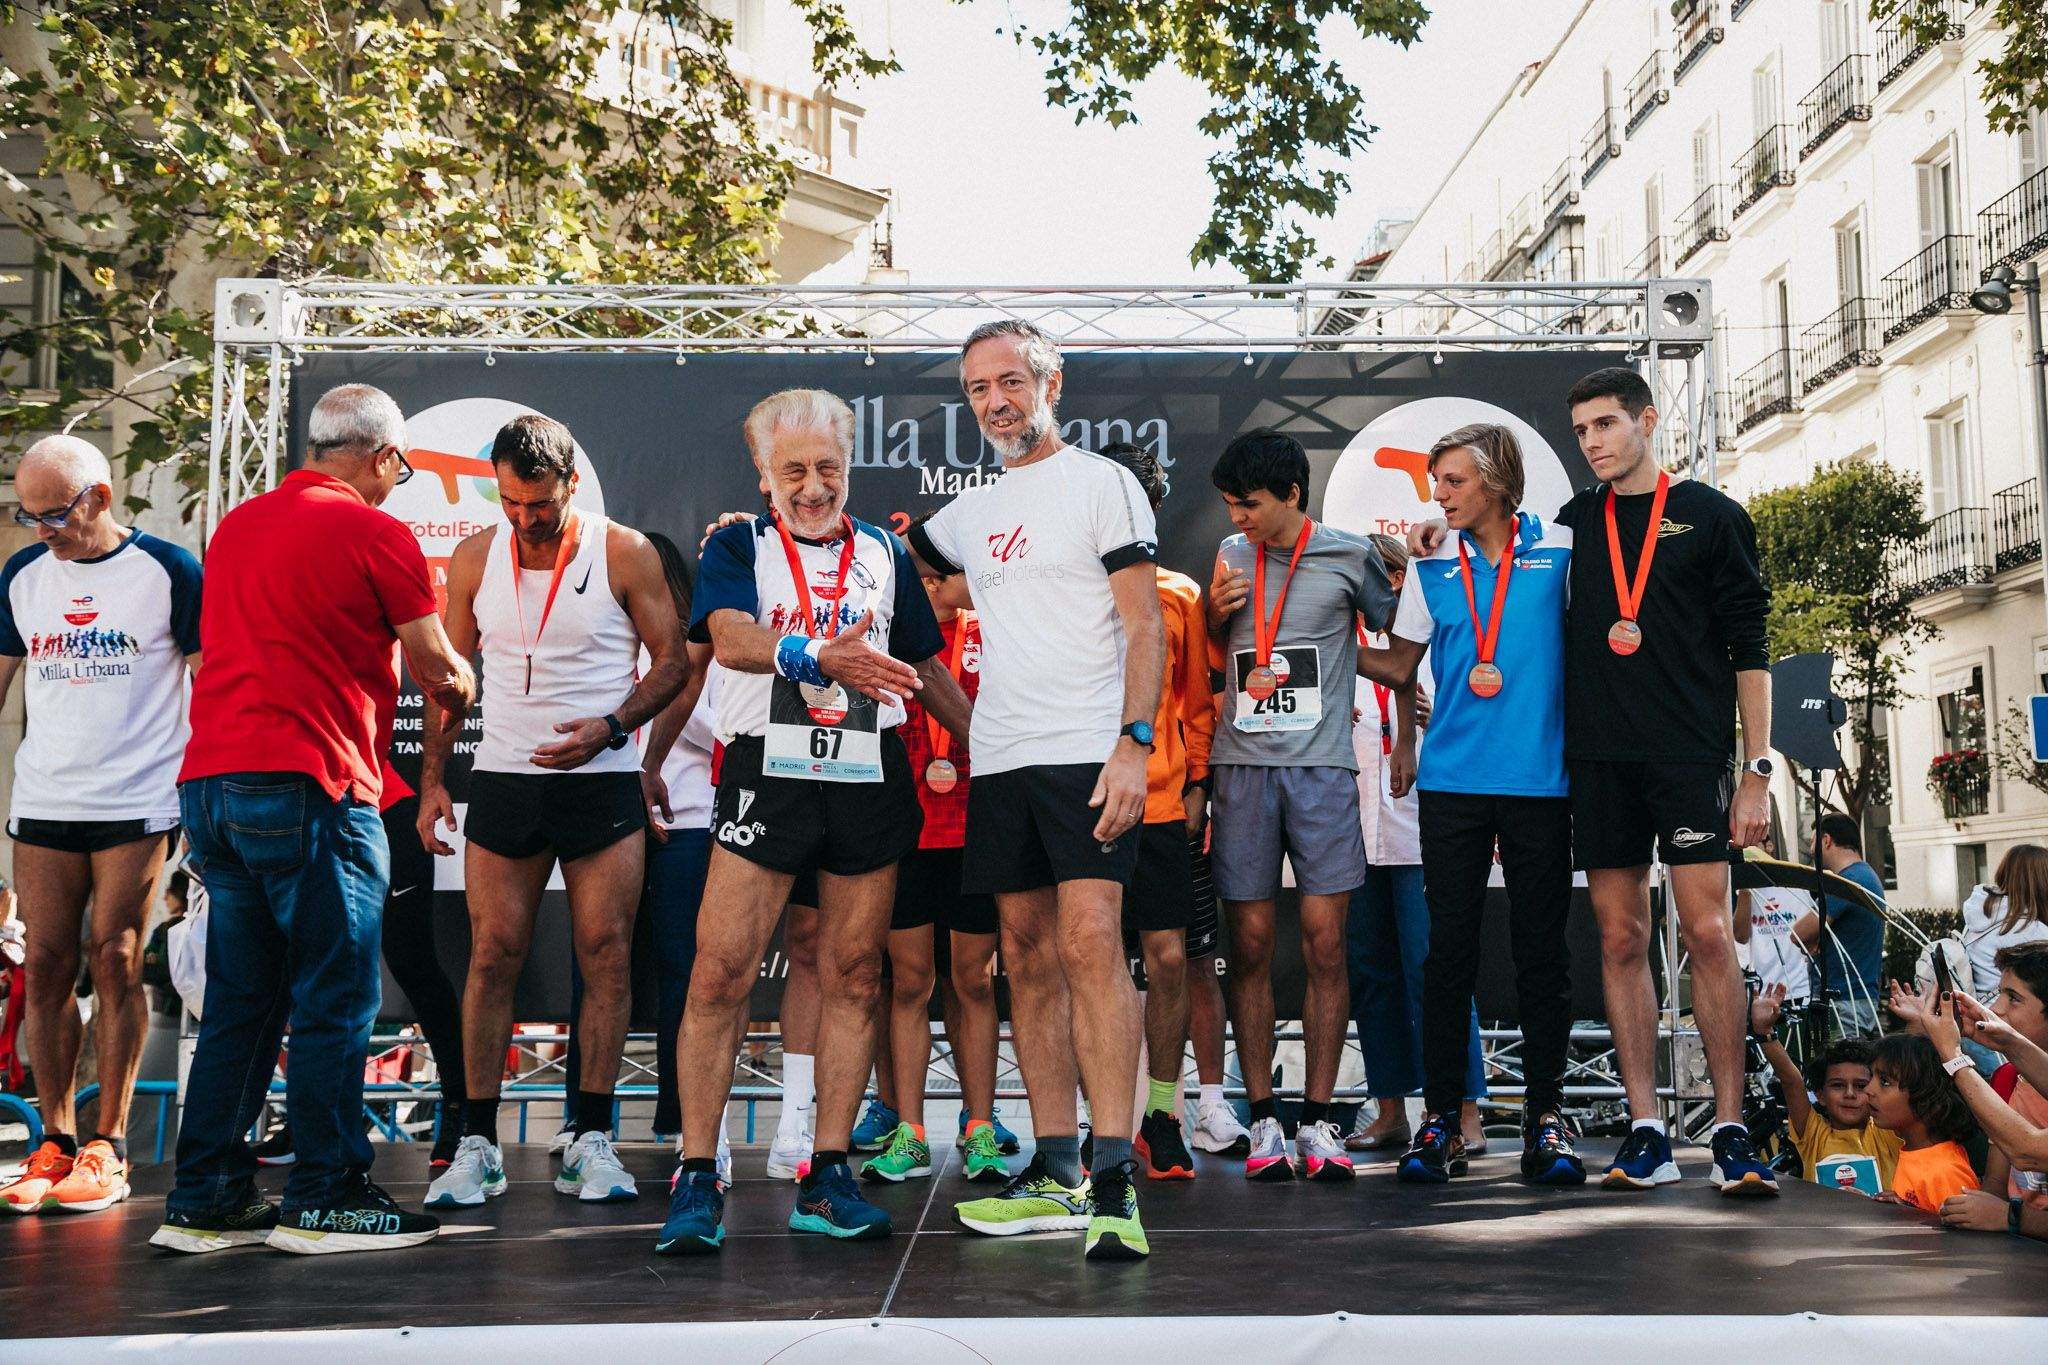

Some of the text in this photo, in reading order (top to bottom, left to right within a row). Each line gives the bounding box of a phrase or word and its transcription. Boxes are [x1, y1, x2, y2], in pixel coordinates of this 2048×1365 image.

[850, 394, 1176, 468] lla Uana
[38, 660, 131, 681] Milla Urbana
[1800, 698, 1822, 710] JTS
[809, 727, 843, 760] 67
[779, 762, 807, 771] MADRID
[299, 1208, 401, 1234] MADRID
